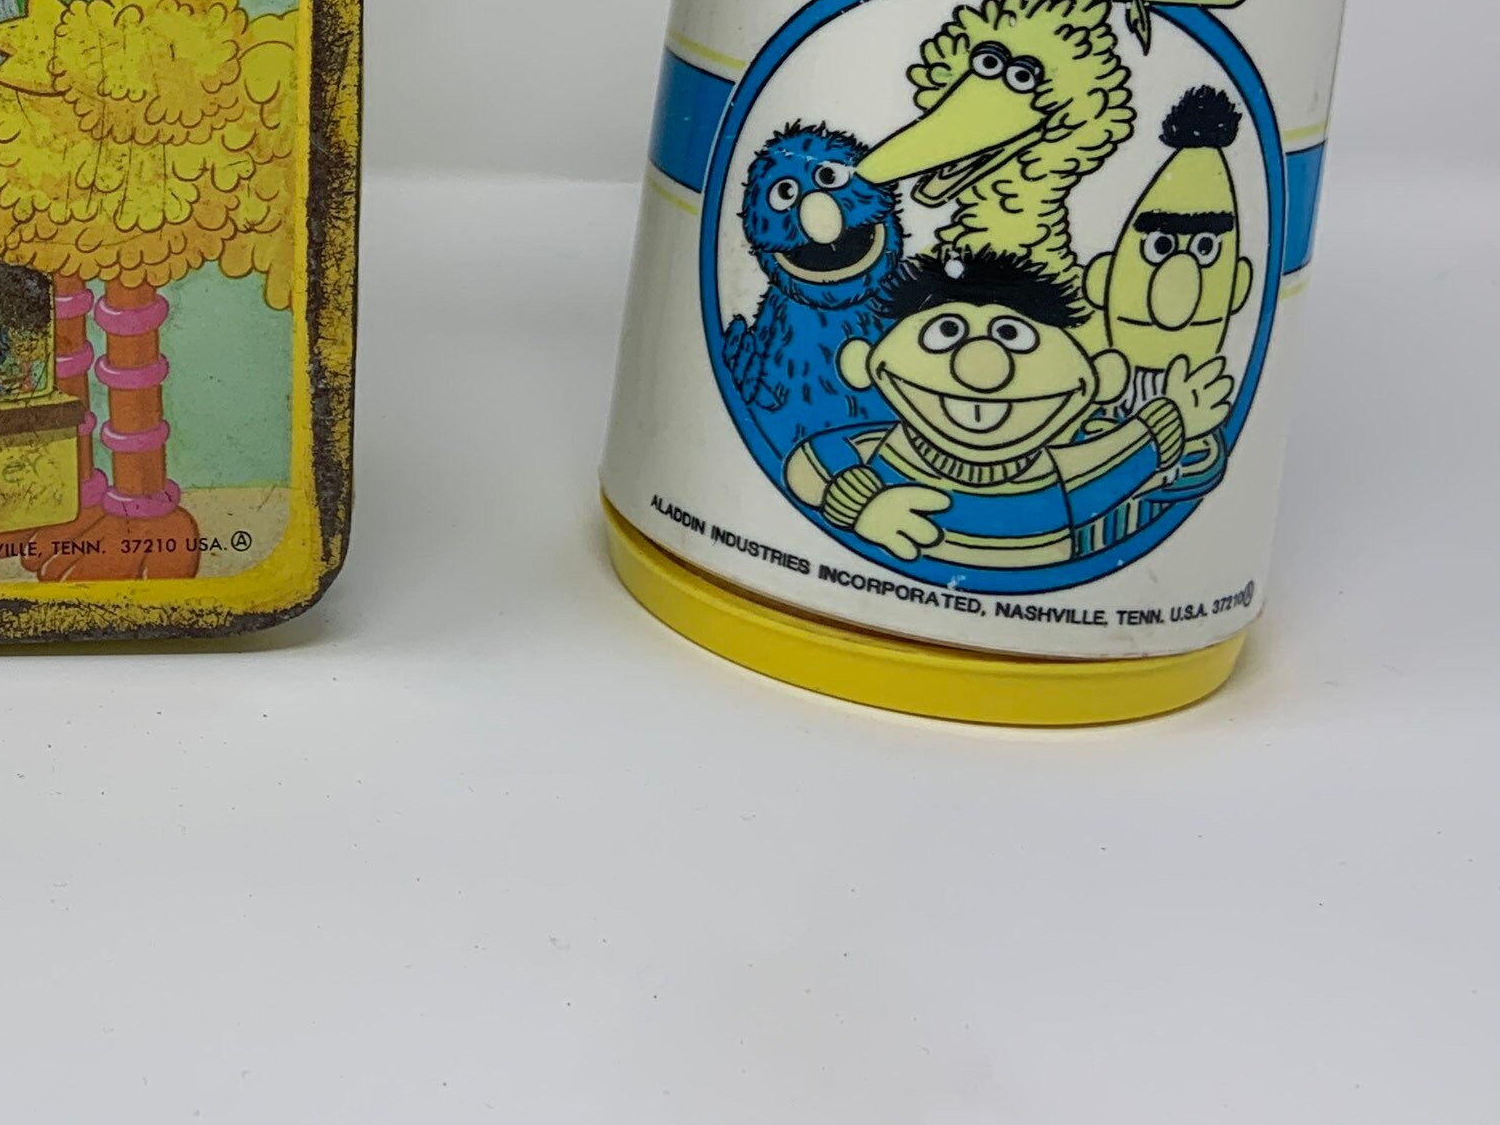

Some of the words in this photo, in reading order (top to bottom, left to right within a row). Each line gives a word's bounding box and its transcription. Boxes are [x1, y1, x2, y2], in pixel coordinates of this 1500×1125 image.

[51, 539, 106, 556] TENN.
[120, 537, 177, 554] 37210
[650, 494, 705, 535] ALADDIN
[711, 525, 811, 575] INDUSTRIES
[818, 564, 986, 617] INCORPORATED,
[995, 601, 1109, 627] NASHVILLE,
[1116, 609, 1165, 627] TENN.
